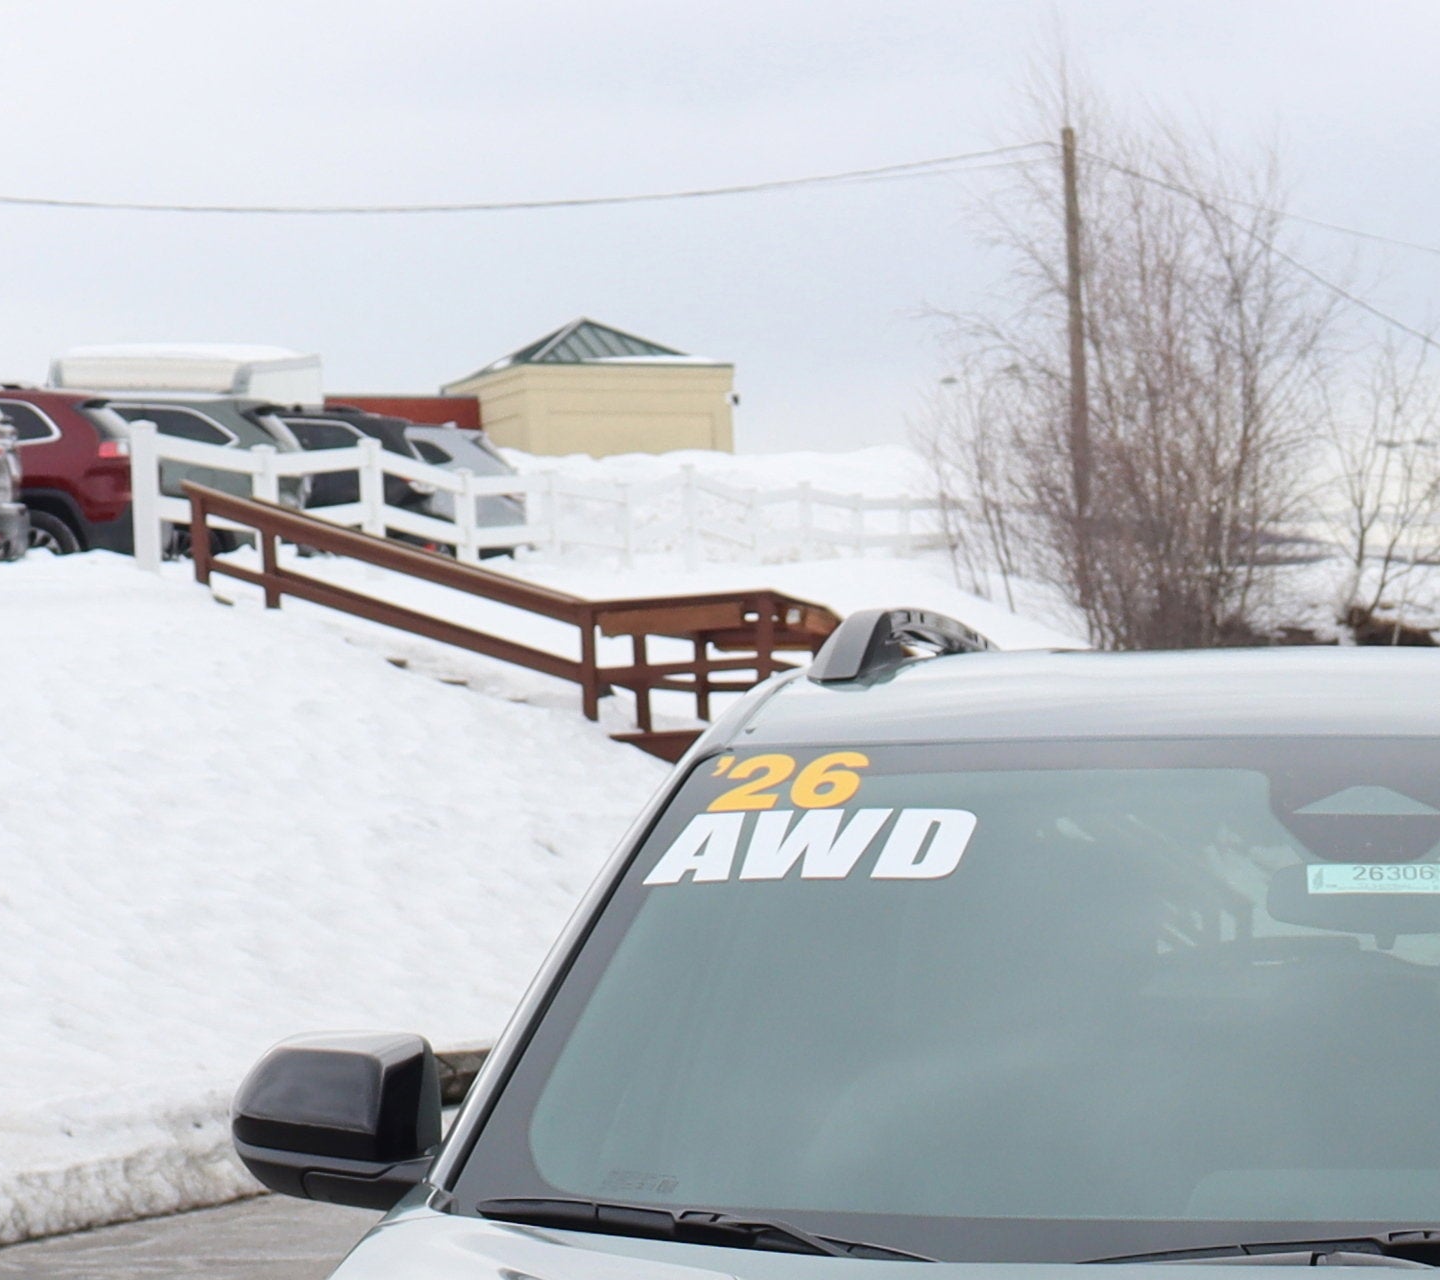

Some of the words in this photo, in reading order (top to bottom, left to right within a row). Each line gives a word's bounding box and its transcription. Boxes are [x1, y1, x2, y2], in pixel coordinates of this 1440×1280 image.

[706, 751, 870, 812] '26
[642, 808, 978, 885] AWD
[1352, 865, 1435, 881] 26306
